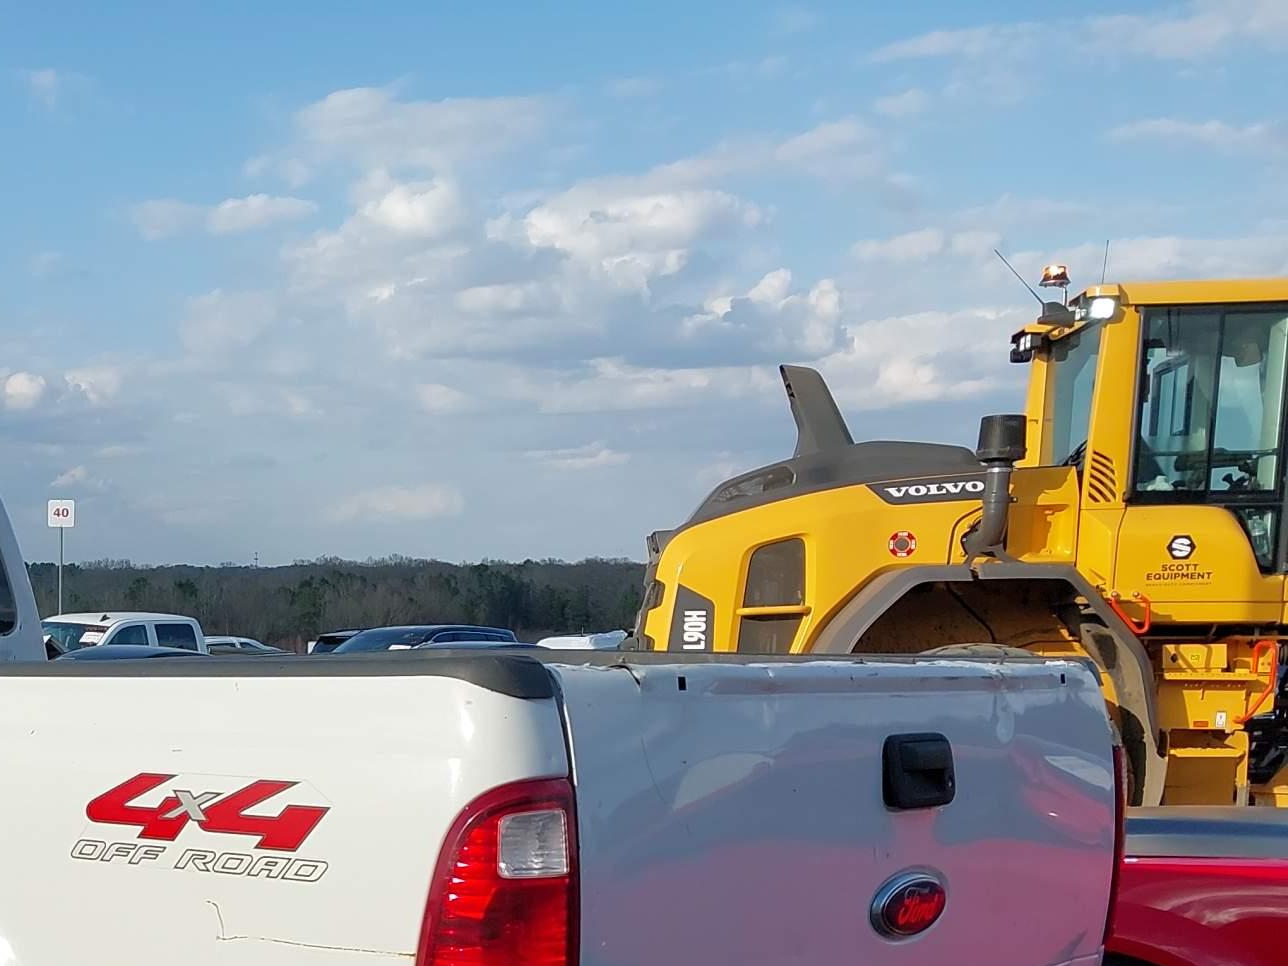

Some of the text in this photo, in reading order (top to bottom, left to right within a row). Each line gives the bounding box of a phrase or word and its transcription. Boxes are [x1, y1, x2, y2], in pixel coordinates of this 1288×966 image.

[884, 481, 985, 498] VOLVO
[52, 507, 70, 518] 40
[1161, 563, 1199, 572] SCOTT
[1146, 572, 1213, 581] EQUIPMENT
[683, 610, 707, 650] L90H
[70, 839, 329, 883] OFF ROAD
